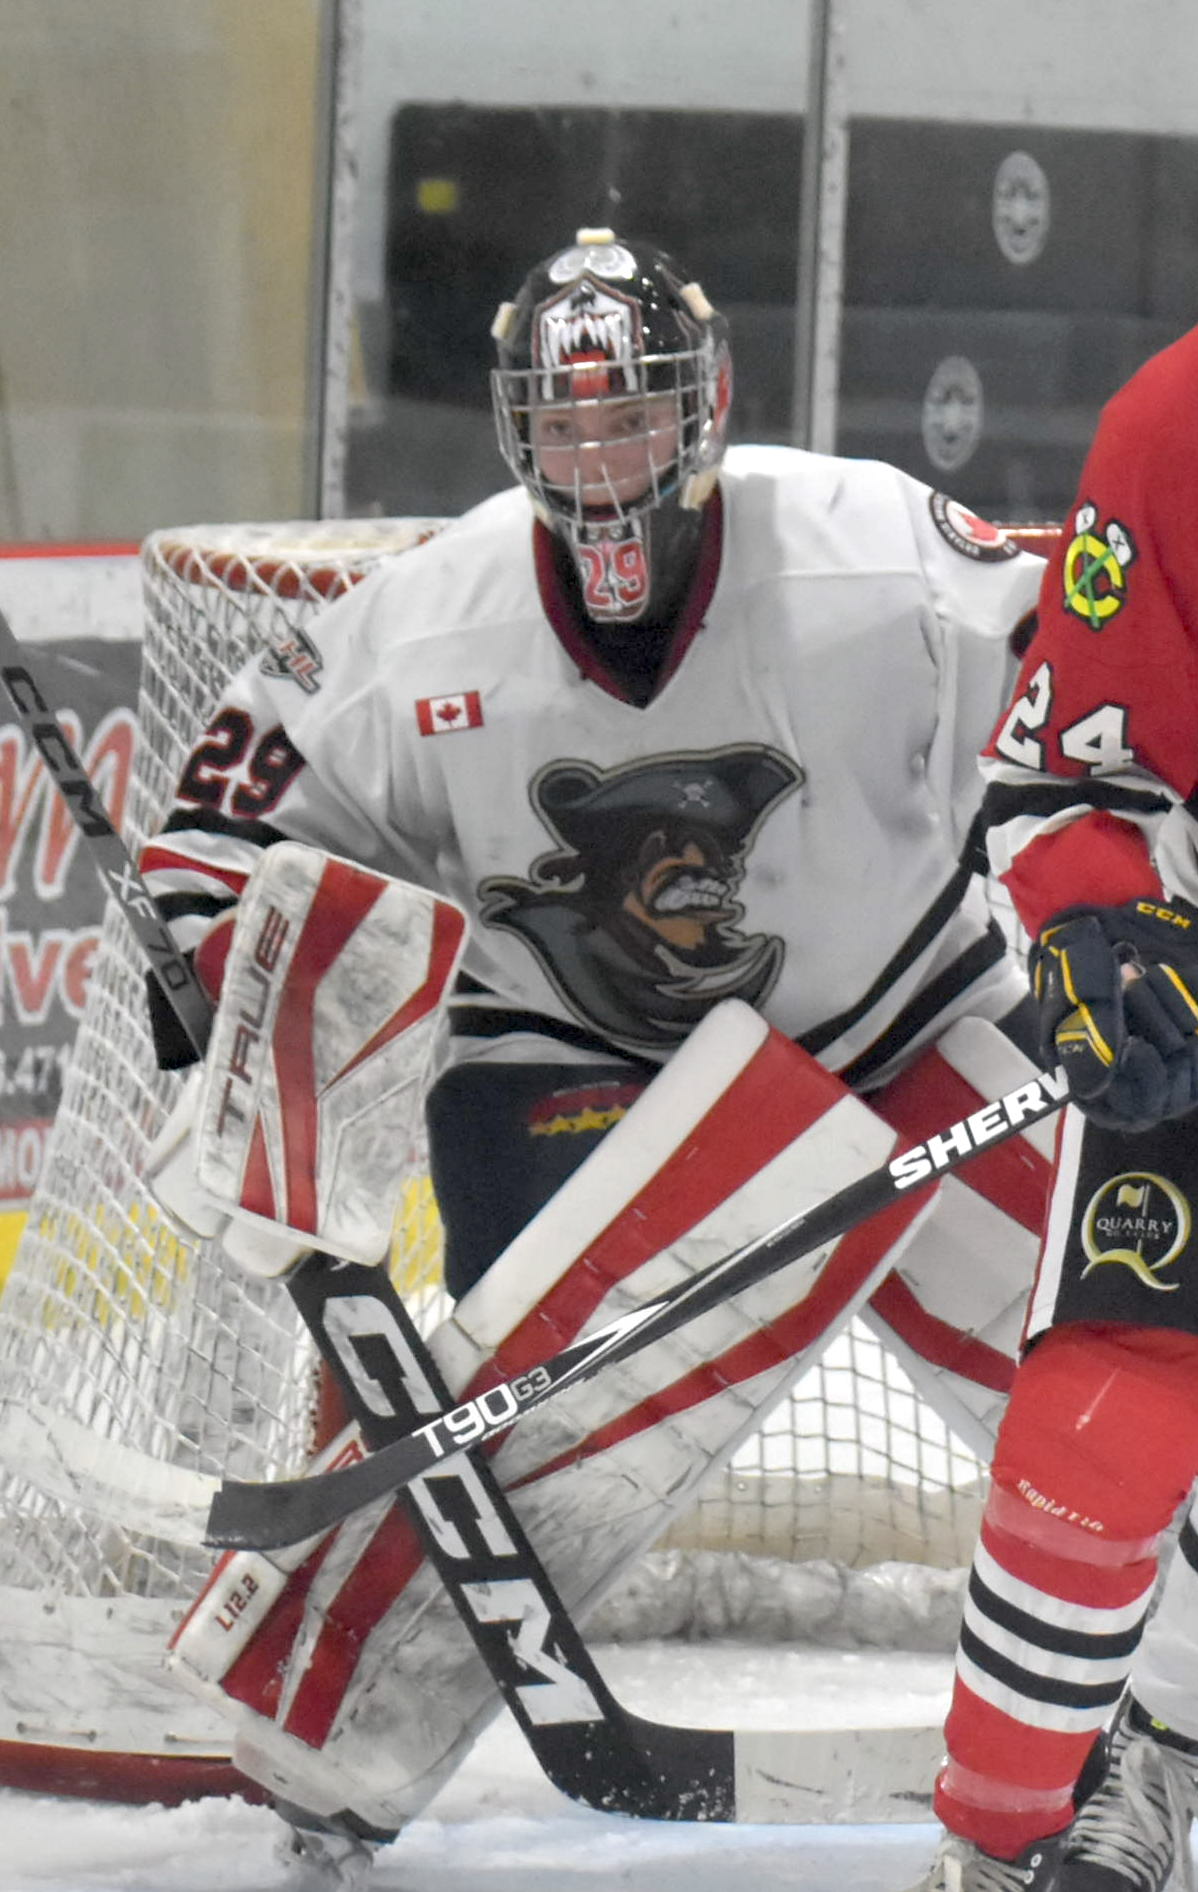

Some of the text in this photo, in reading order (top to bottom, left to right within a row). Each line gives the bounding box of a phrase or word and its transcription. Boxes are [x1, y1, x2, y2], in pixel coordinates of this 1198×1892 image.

[577, 540, 648, 607] 29
[176, 706, 306, 818] 29
[996, 661, 1133, 768] 24
[2, 665, 190, 991] CCM XF 70
[1136, 902, 1192, 929] CCM
[0, 922, 105, 1025] ve
[217, 904, 290, 1138] TRUE
[1096, 1217, 1173, 1234] QUARRY
[323, 1294, 605, 1727] CCM
[214, 1573, 259, 1632] L12.2
